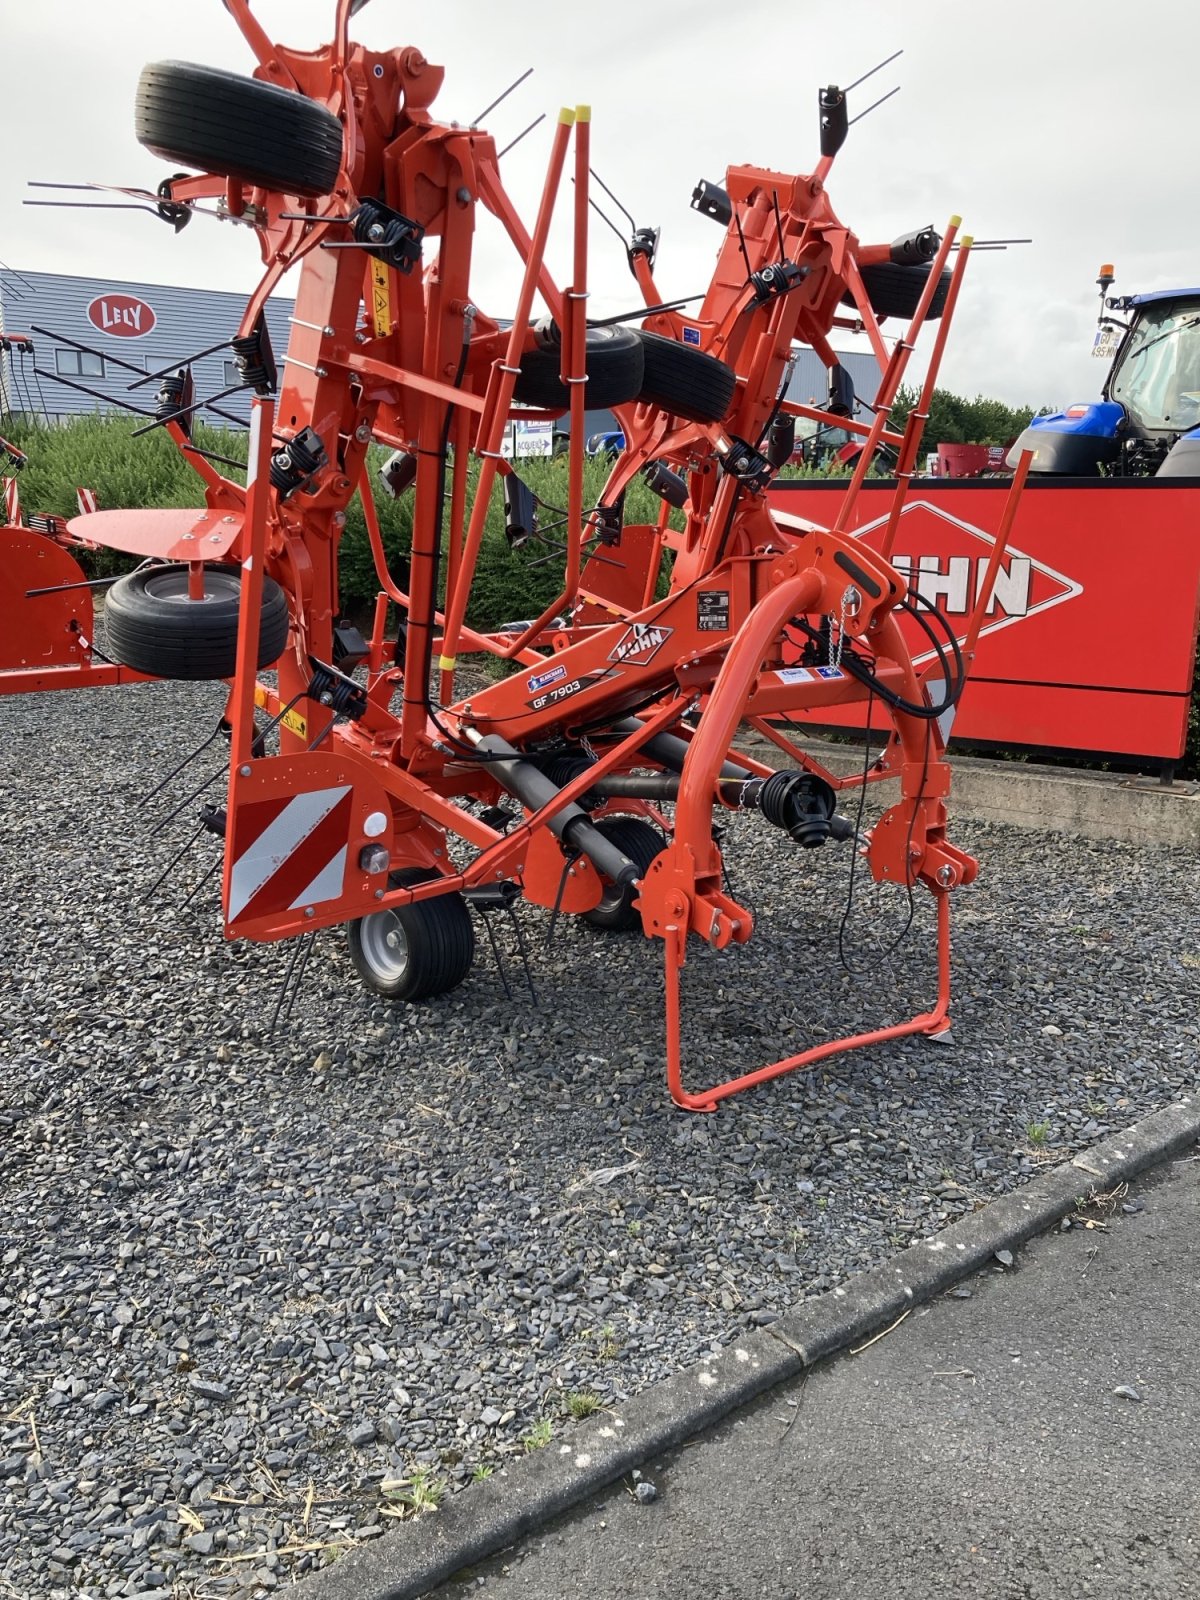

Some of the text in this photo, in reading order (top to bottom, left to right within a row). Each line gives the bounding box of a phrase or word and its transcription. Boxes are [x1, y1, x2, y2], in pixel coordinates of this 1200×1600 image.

[101, 301, 142, 331] LELY
[891, 555, 1031, 616] HN
[617, 630, 663, 659] KUHN
[533, 681, 581, 709] GF 7903
